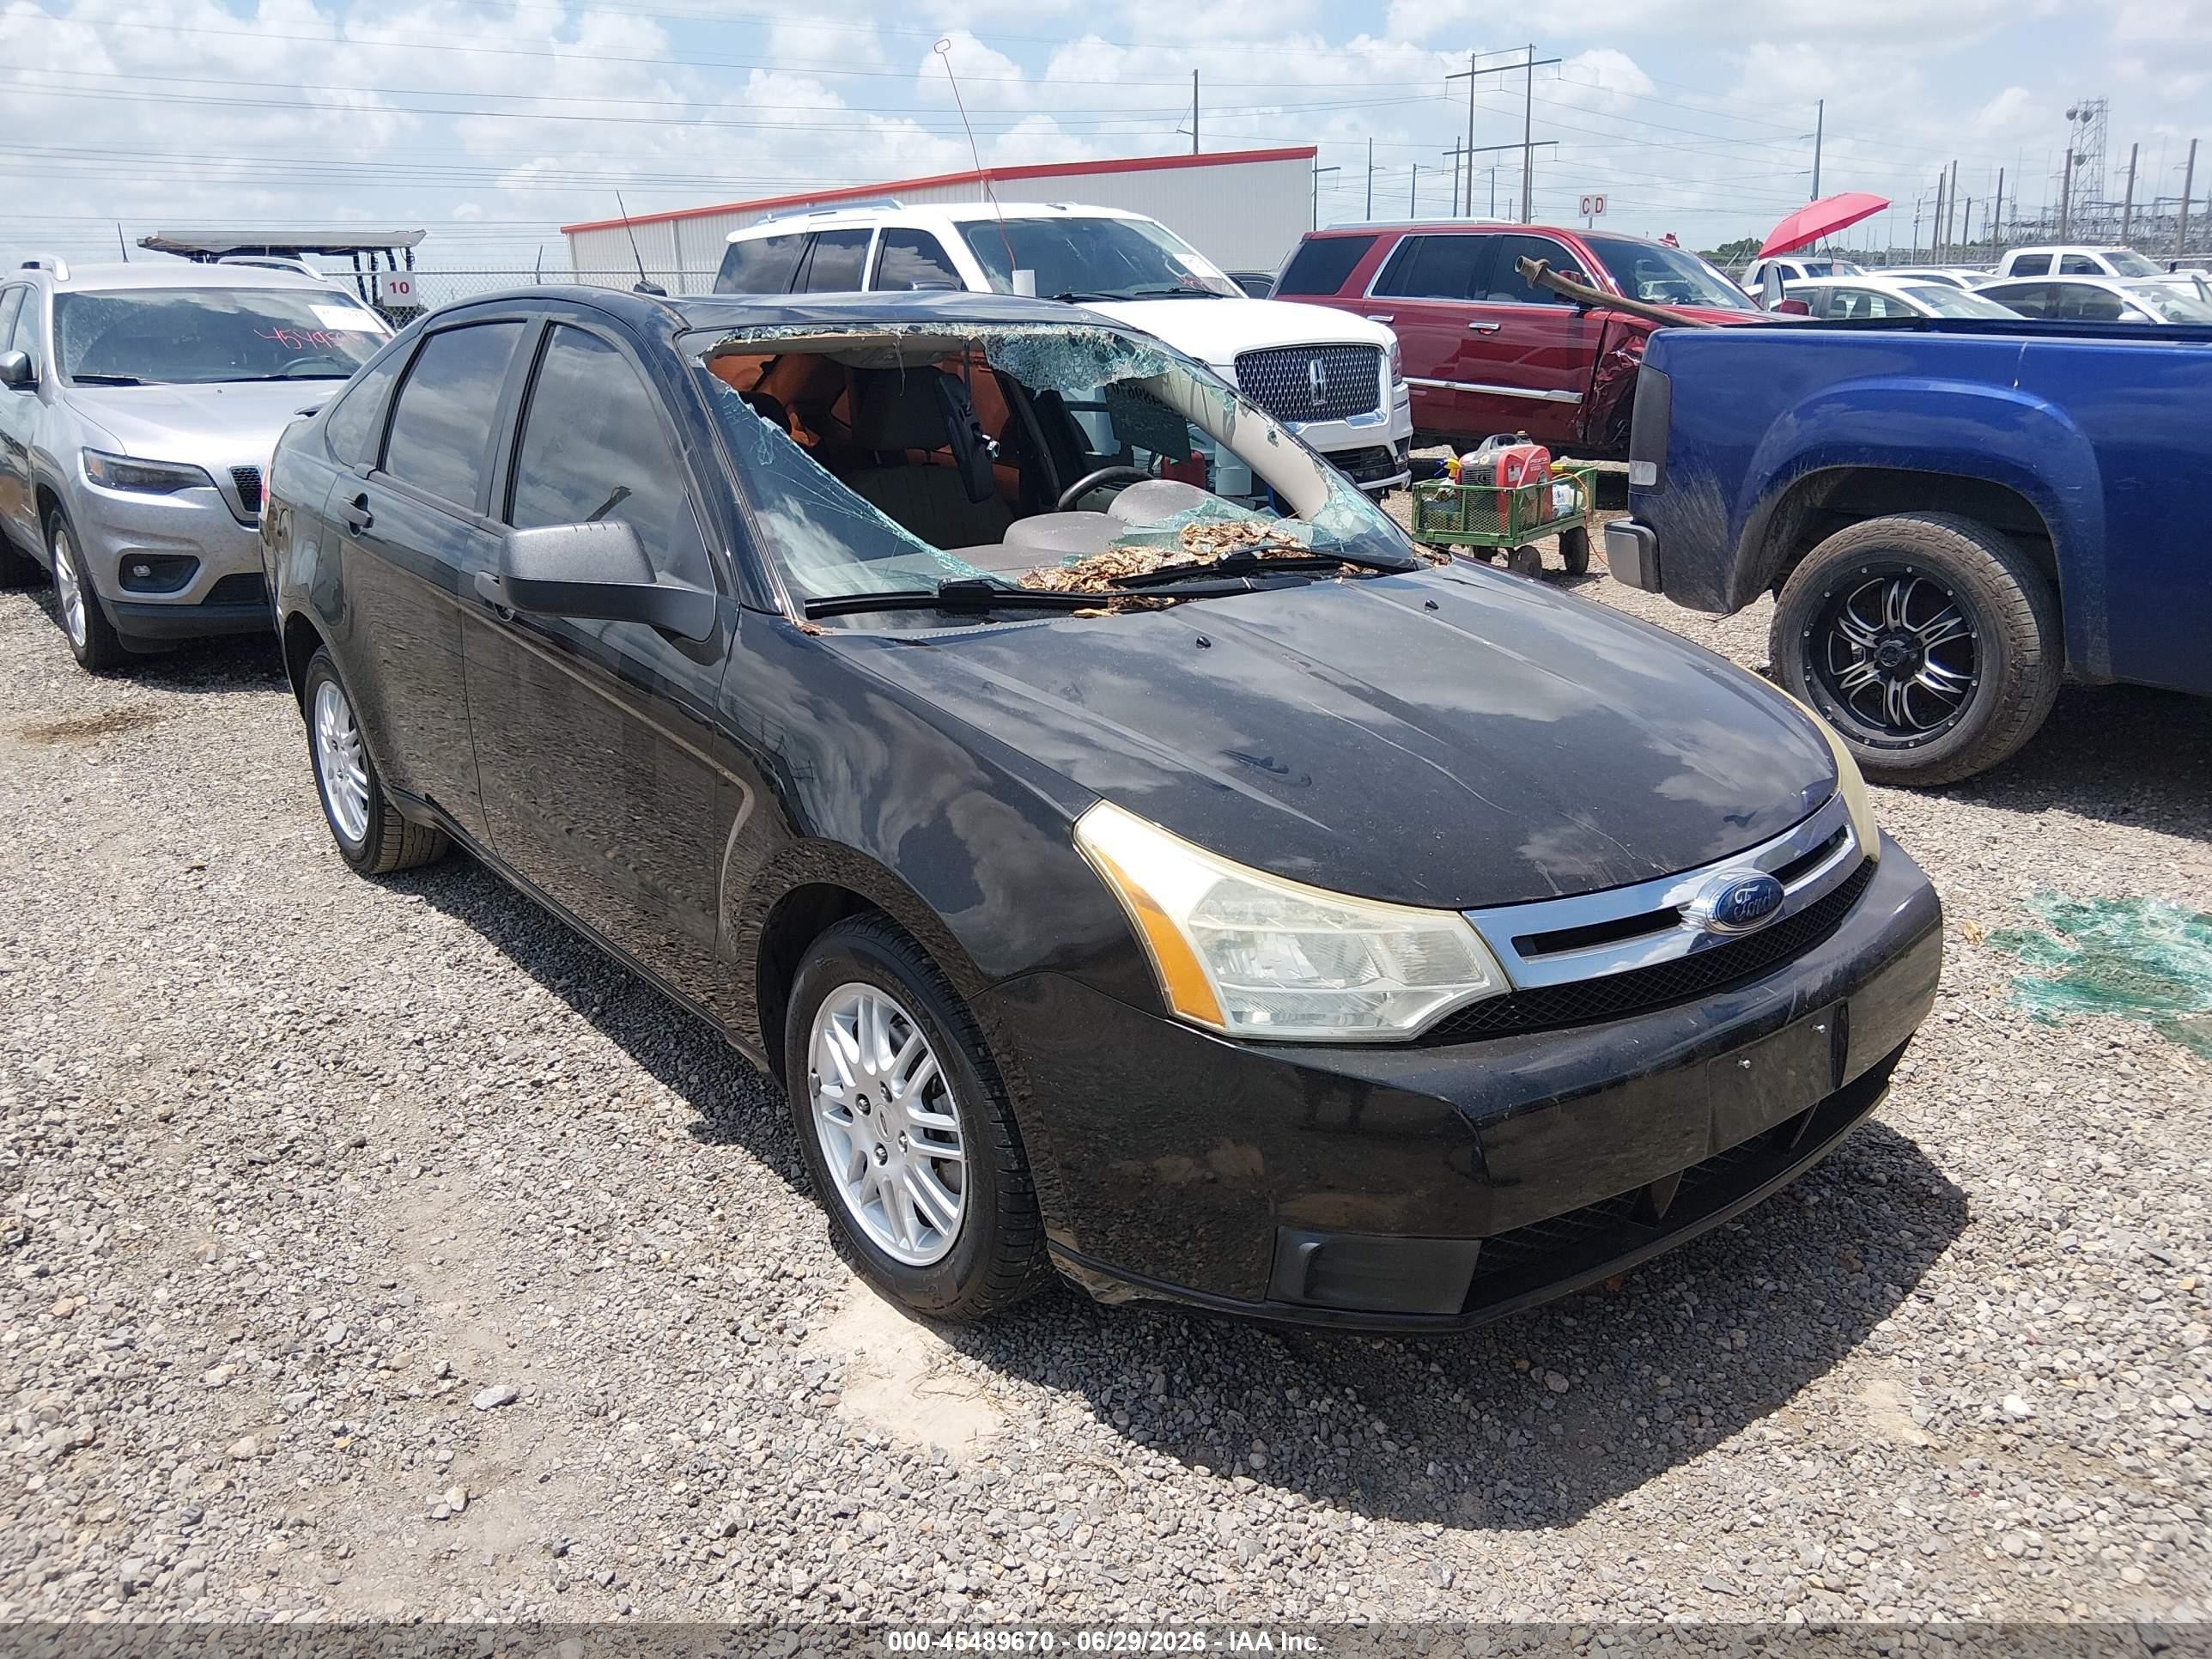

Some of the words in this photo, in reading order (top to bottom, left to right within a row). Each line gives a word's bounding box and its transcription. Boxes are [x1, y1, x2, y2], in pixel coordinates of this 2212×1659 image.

[1582, 198, 1589, 214] C
[1595, 197, 1603, 213] D
[389, 281, 410, 295] 10
[1733, 884, 1771, 921] Ford
